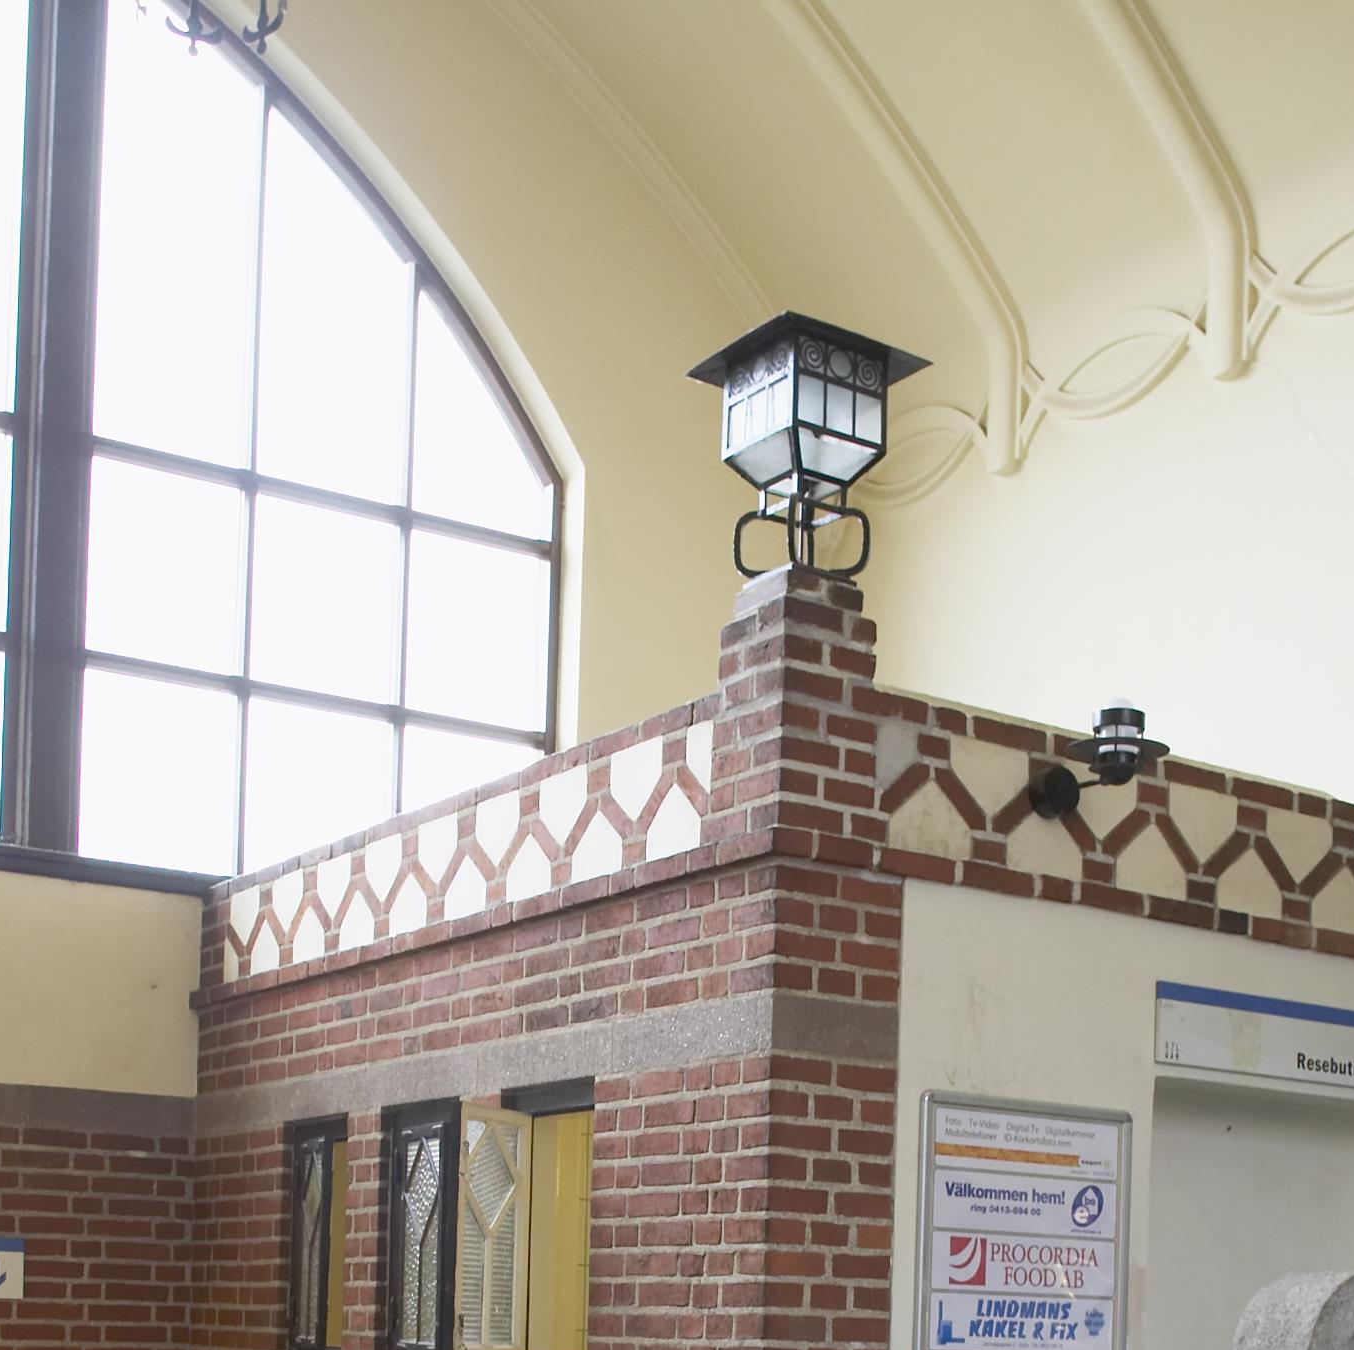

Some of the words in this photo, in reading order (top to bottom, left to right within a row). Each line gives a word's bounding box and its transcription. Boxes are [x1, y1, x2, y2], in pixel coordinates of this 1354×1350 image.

[945, 1181, 1028, 1202] Välkommen
[1032, 1188, 1066, 1205] hem!
[971, 1202, 987, 1214] ring
[990, 1242, 1099, 1268] PROCORDIA
[1003, 1266, 1056, 1288] FOOD
[1060, 1269, 1084, 1289] AB
[976, 1299, 1072, 1320] LINDMANS
[968, 1319, 1026, 1339] KAKEL
